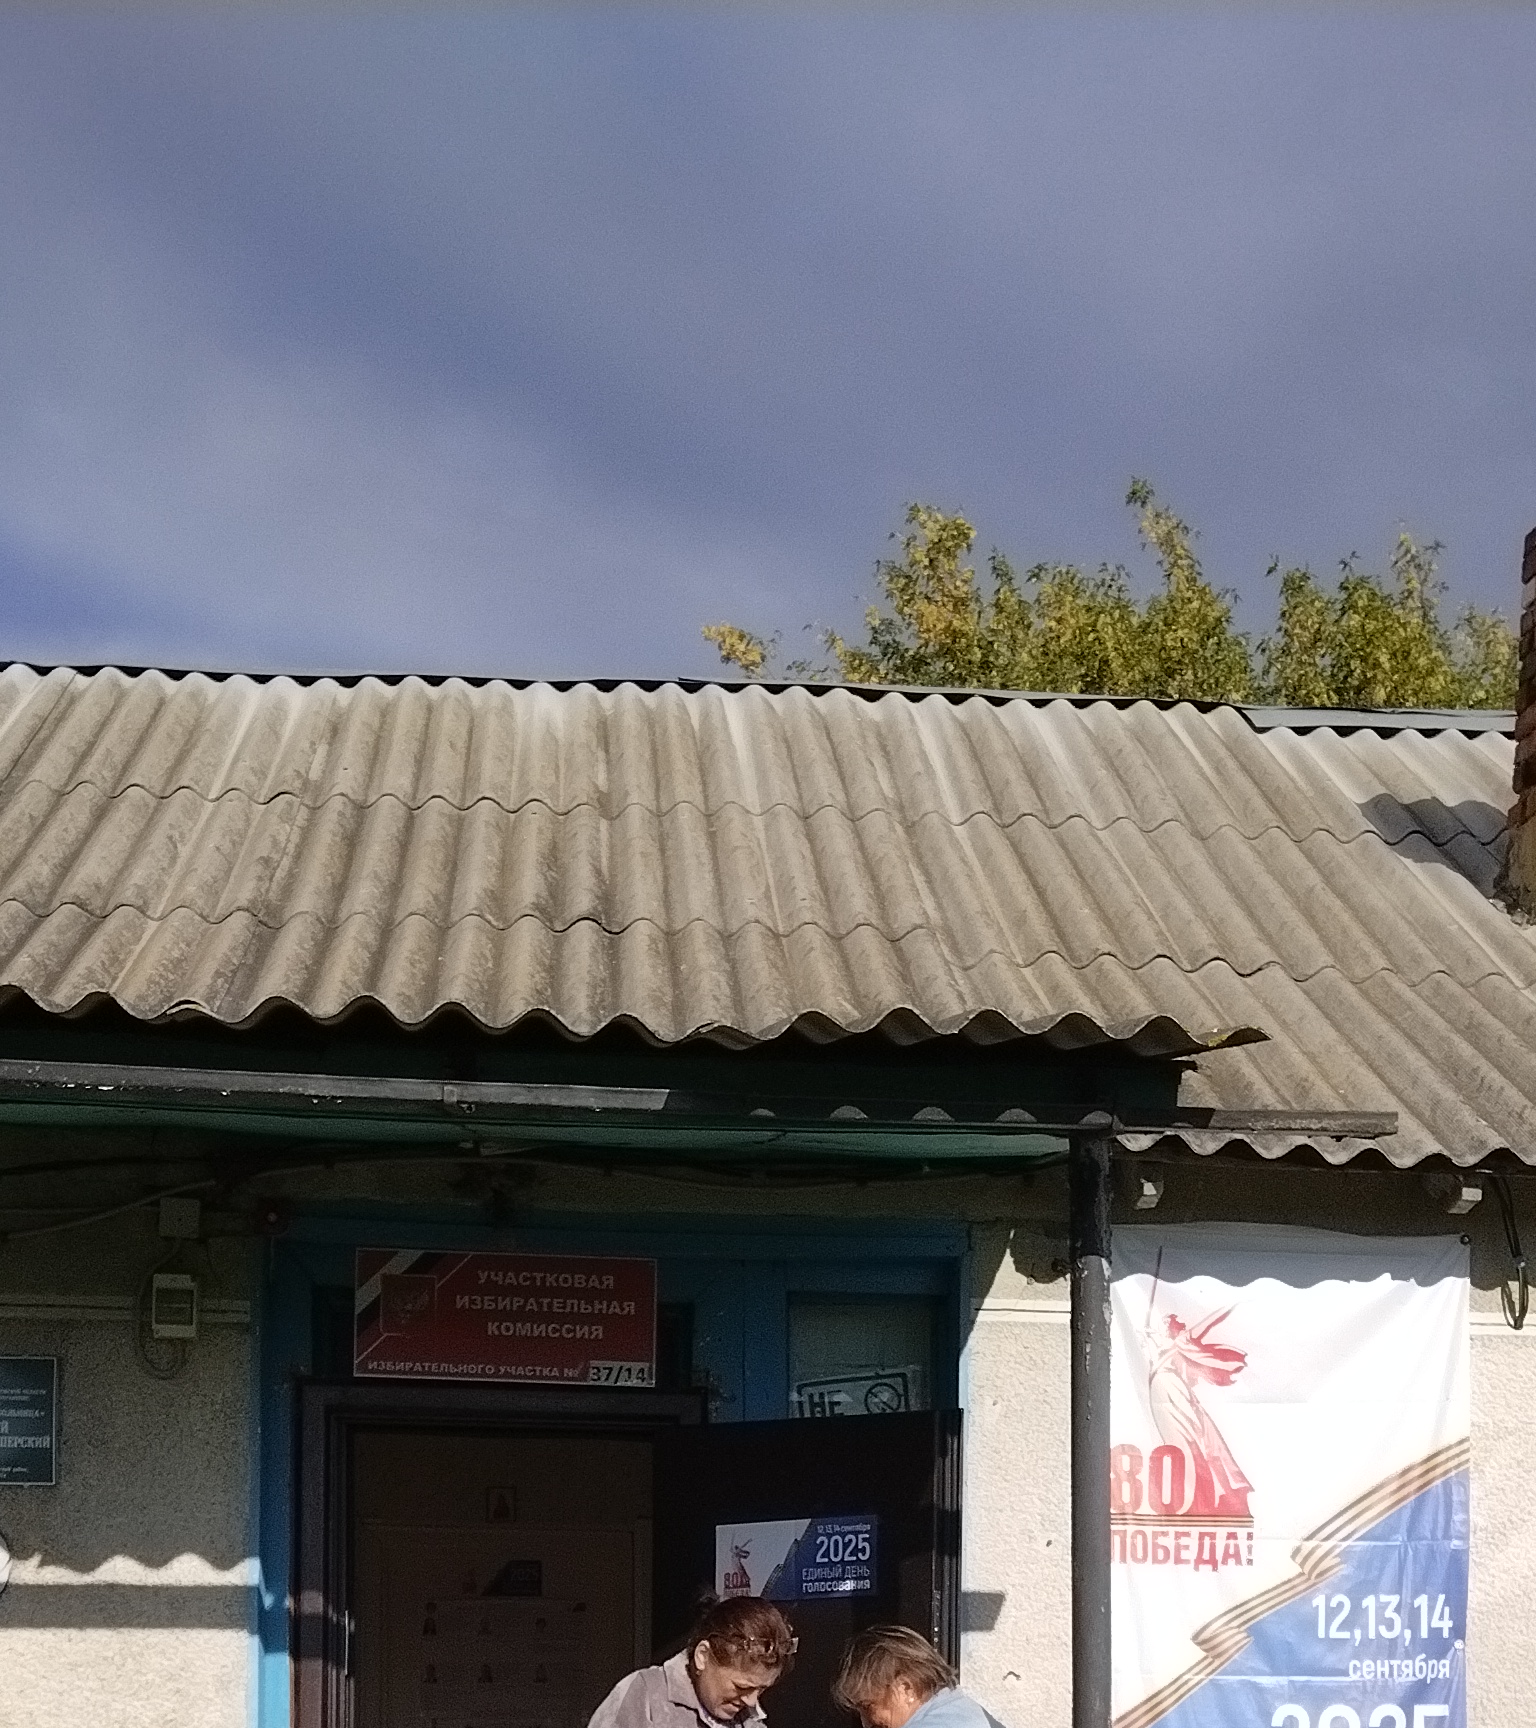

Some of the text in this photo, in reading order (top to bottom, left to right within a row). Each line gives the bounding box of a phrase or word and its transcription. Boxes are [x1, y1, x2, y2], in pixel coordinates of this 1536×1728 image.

[477, 1270, 616, 1290] УЧАСТКОВАЯ
[455, 1294, 637, 1316] ИЗБИРАТЕЛЬНАЯ
[487, 1321, 604, 1340] КОМИССИЯ
[367, 1360, 496, 1376] ИЗБИРАТЕЛЬНОГО
[499, 1365, 560, 1378] УЧАСТКА
[590, 1365, 647, 1385] 37/14
[1110, 1443, 1186, 1515] 80
[816, 1534, 871, 1563] 2025
[1110, 1529, 1255, 1572] ПОБЕДА!
[802, 1564, 870, 1580] ЕДИНЫЙ ДЕНЬ
[1348, 1653, 1451, 1684] сентября
